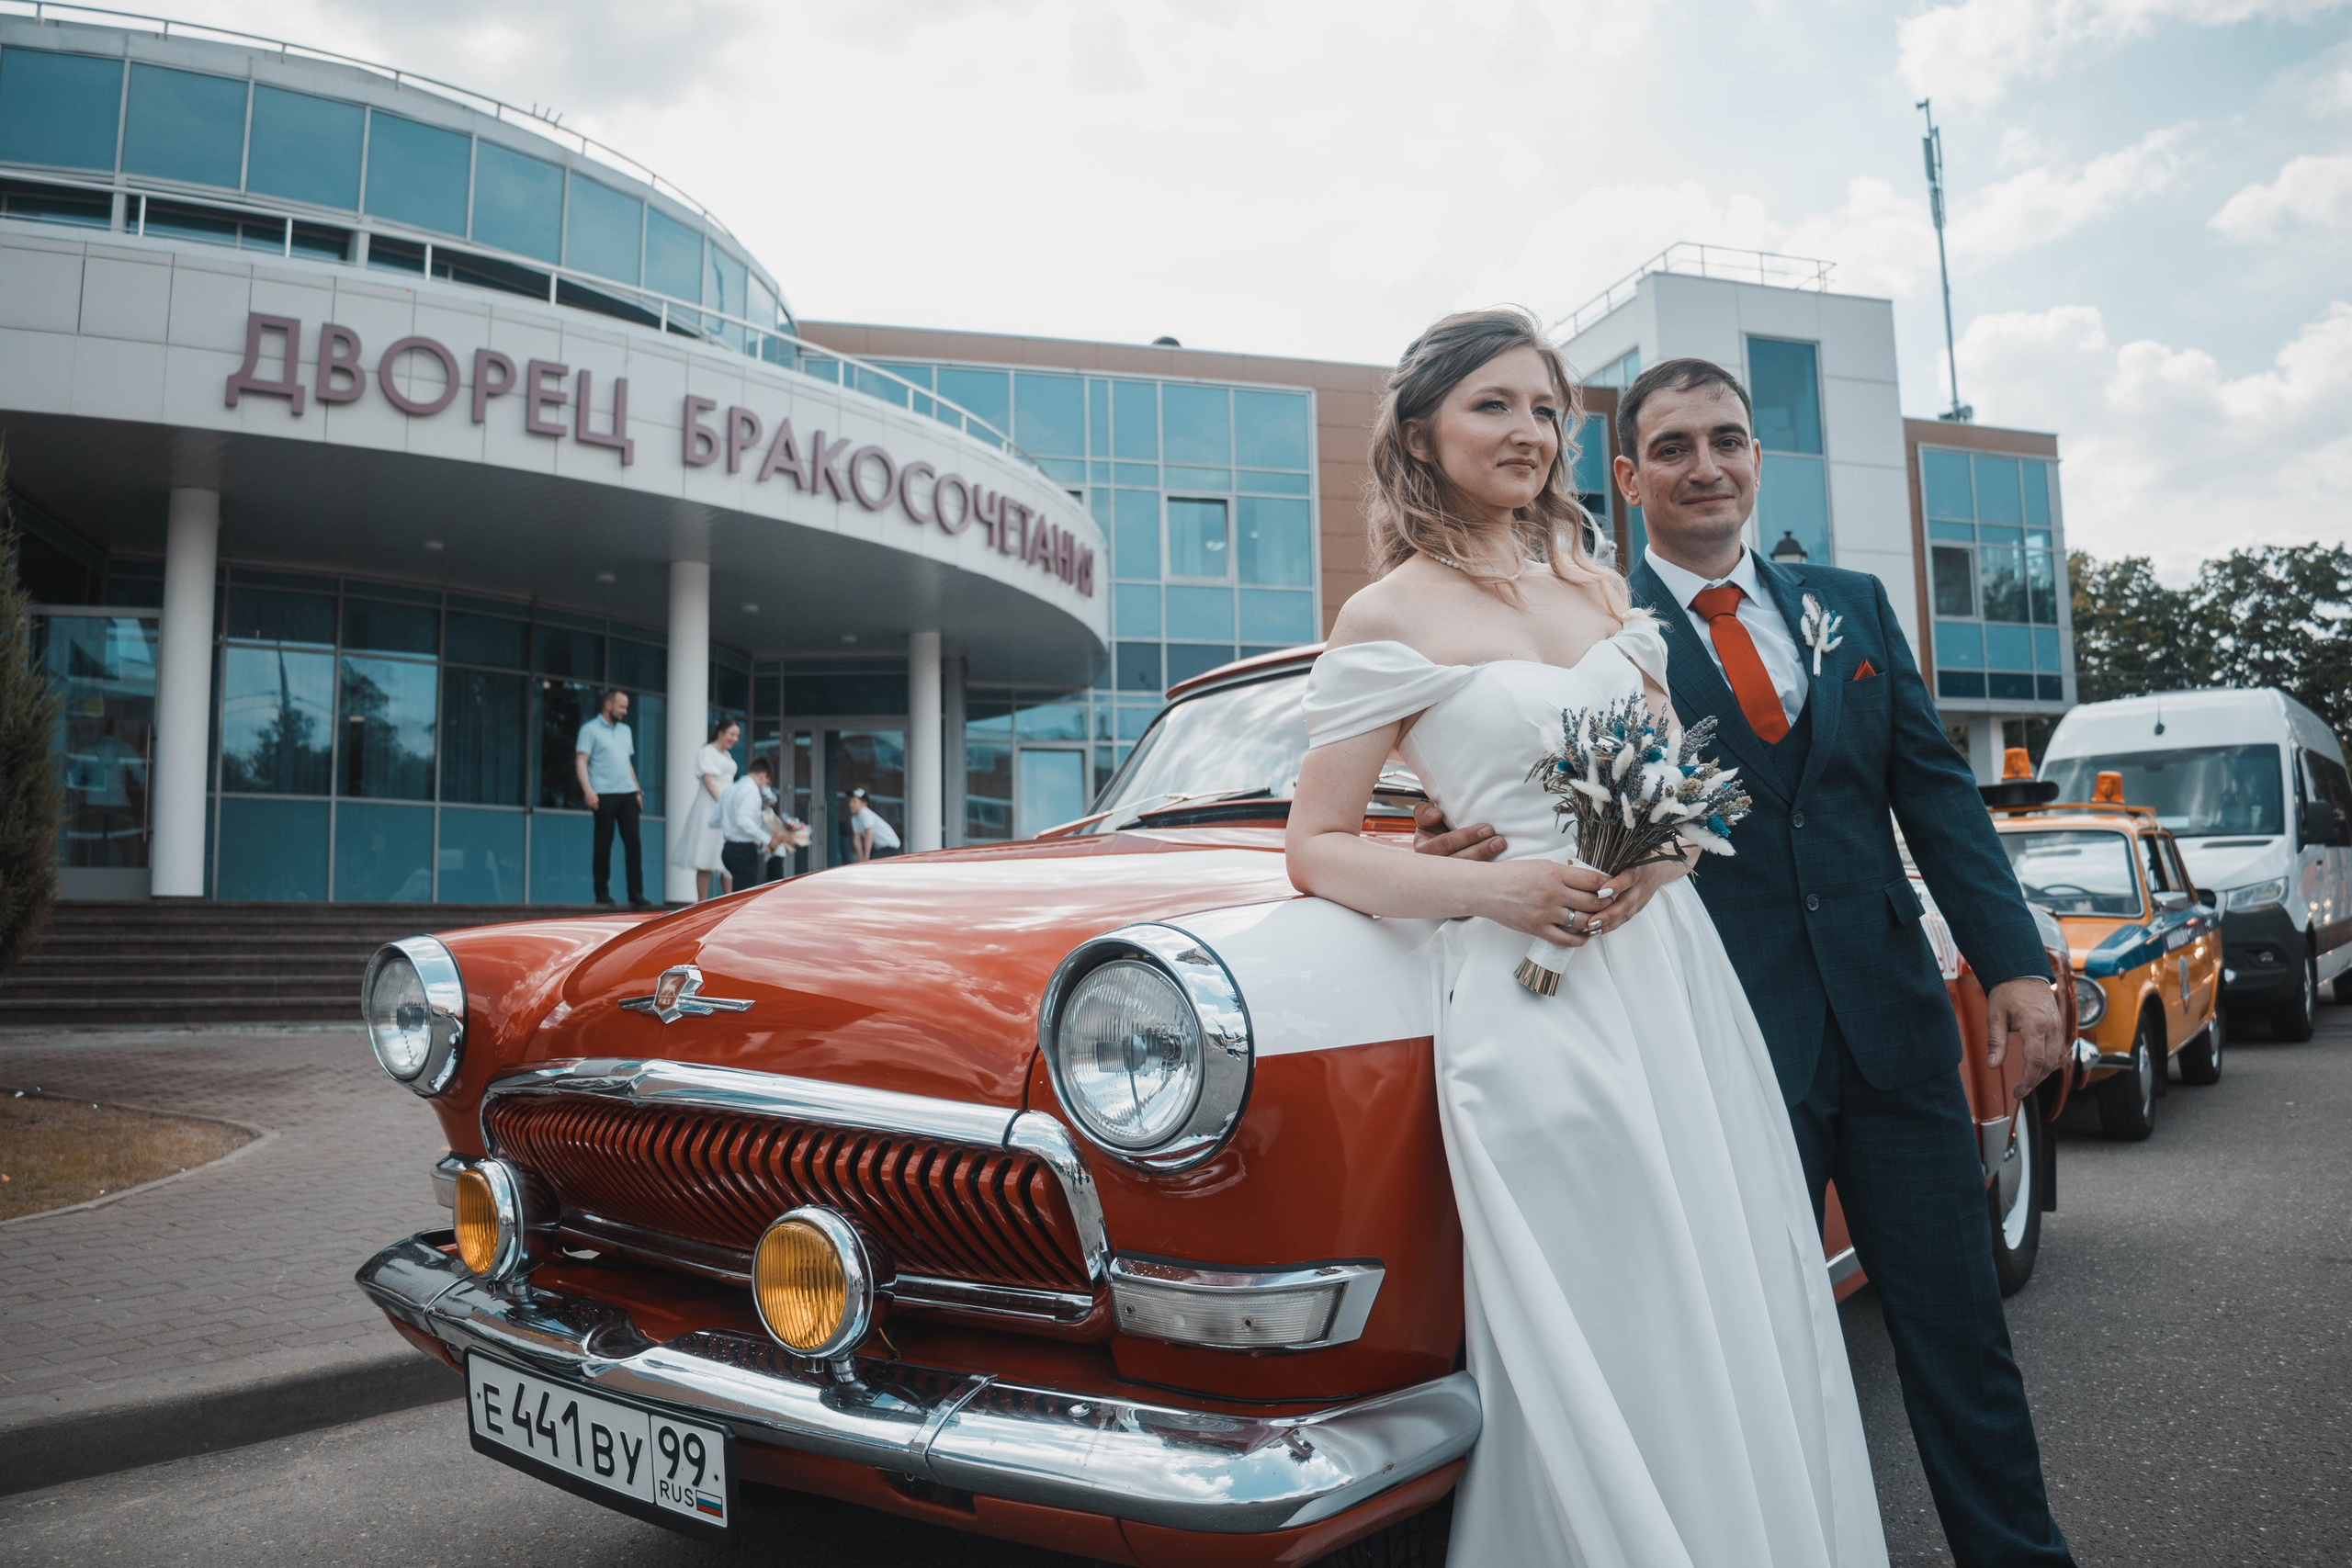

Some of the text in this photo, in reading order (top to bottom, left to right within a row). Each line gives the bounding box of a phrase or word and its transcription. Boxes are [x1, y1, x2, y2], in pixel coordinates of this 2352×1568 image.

[224, 311, 634, 466] ДВОРЕЦ
[657, 1425, 707, 1487] 99
[659, 1479, 695, 1507] RUS
